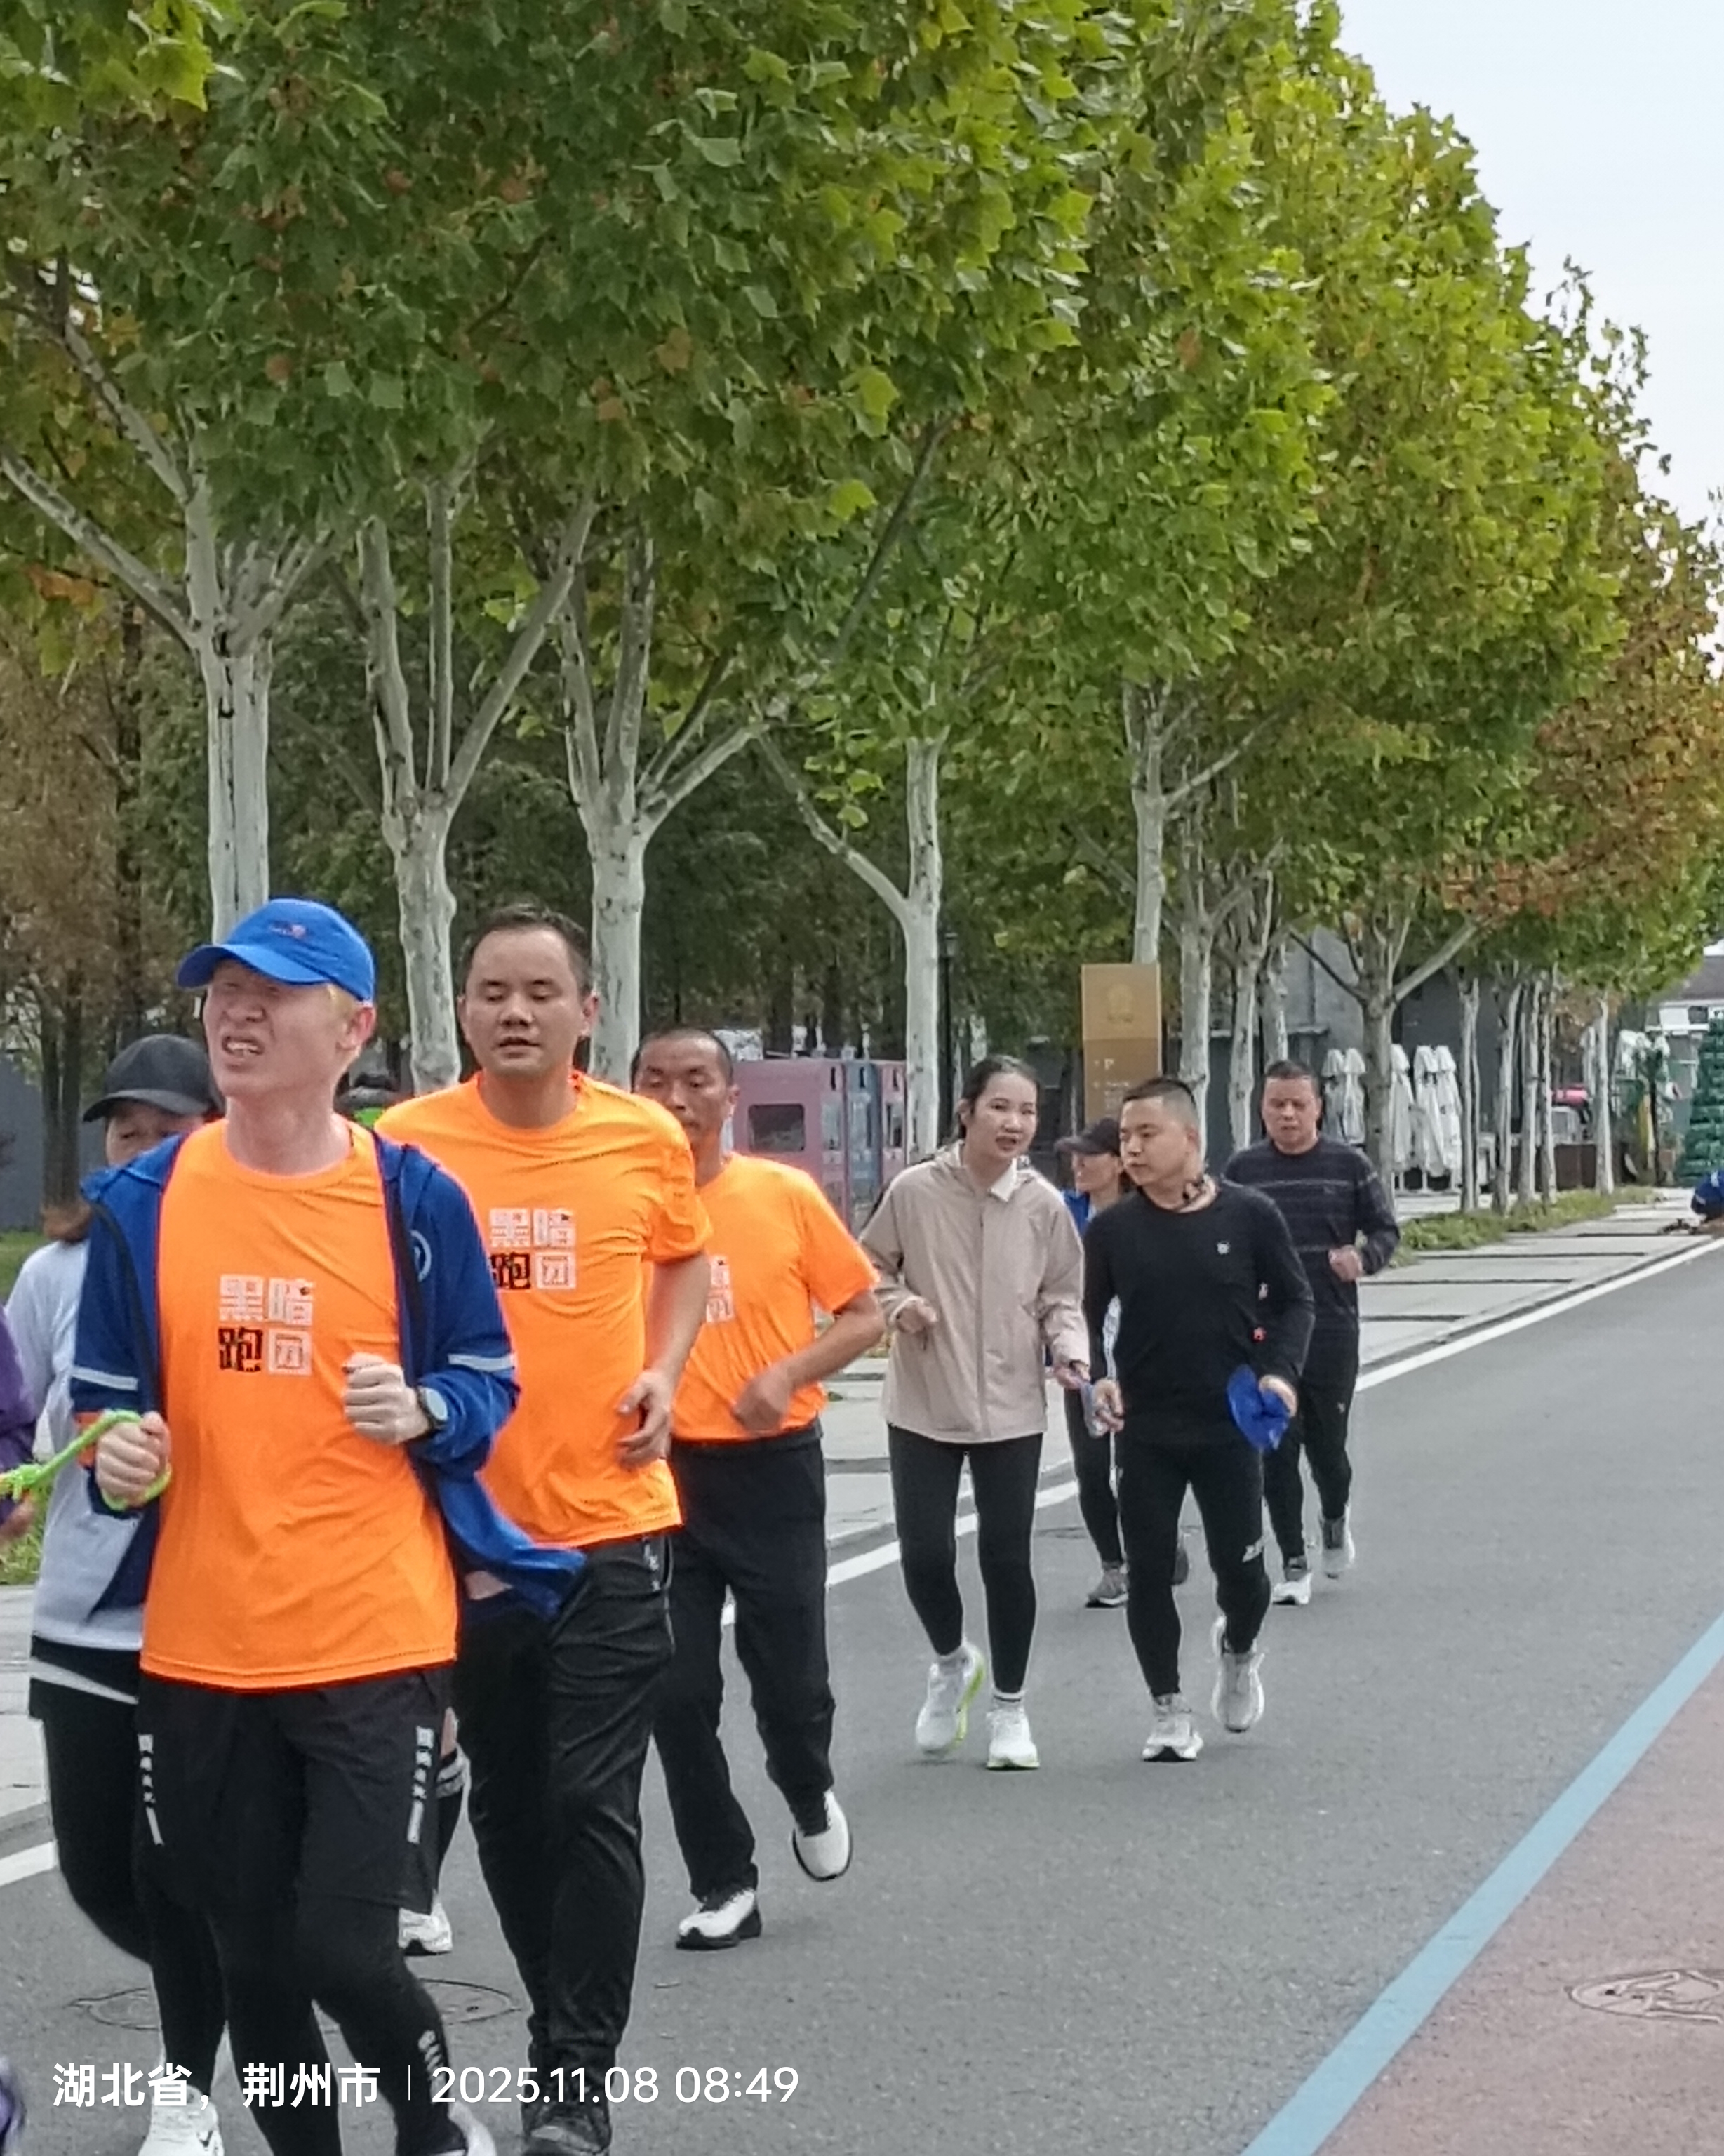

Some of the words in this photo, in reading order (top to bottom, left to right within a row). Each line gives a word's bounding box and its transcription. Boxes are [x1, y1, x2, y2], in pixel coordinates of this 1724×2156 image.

[490, 1208, 576, 1248] 黑暗
[490, 1252, 576, 1289] 跑团
[219, 1274, 313, 1326] 黑暗
[218, 1326, 313, 1376] 跑团
